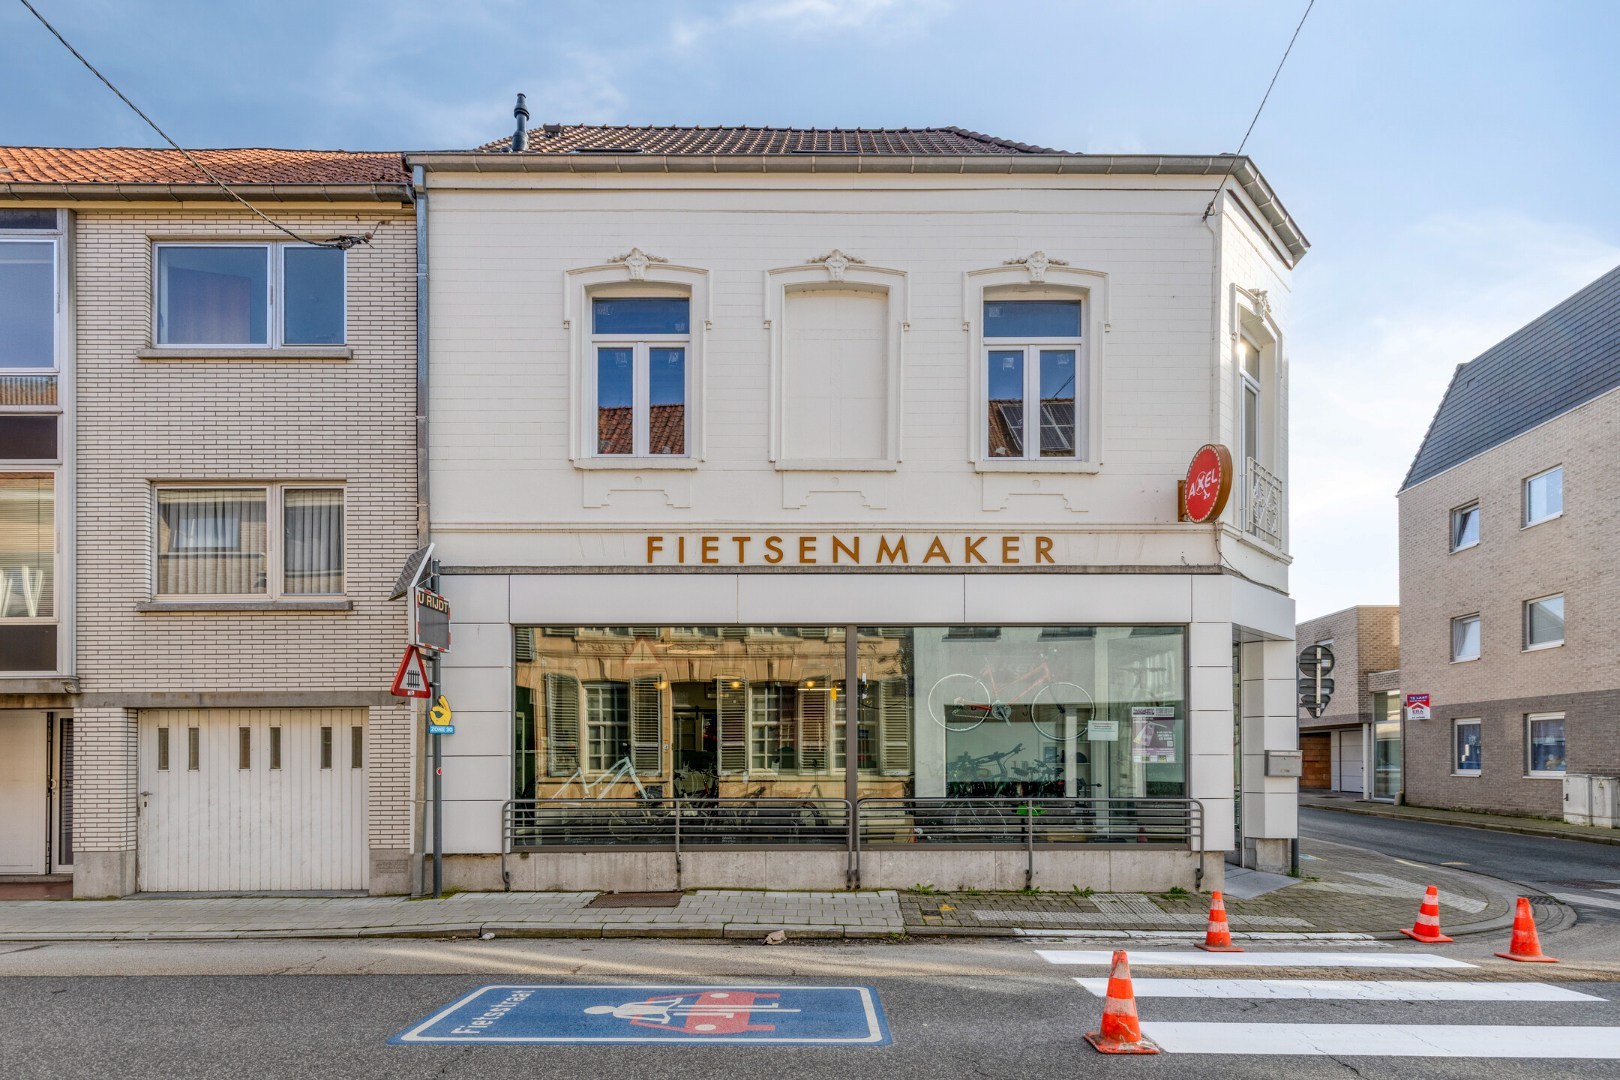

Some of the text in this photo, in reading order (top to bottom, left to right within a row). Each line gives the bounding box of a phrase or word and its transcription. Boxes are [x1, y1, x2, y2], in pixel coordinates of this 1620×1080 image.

[1188, 468, 1217, 500] AXEL
[647, 535, 1056, 564] FIETSENMAKER
[418, 592, 448, 613] U RIJDT
[450, 990, 535, 1034] Fietsstraat
